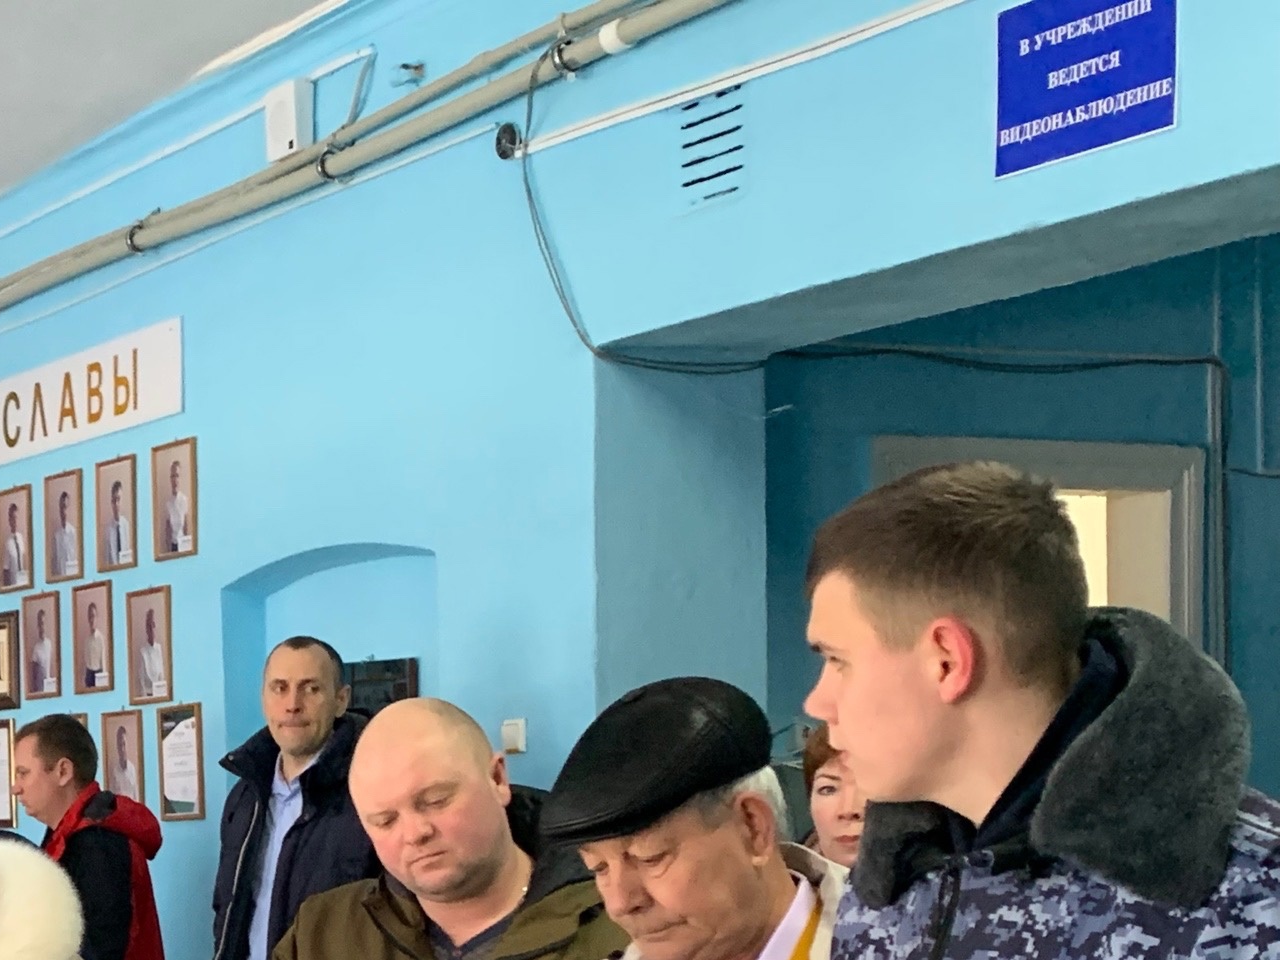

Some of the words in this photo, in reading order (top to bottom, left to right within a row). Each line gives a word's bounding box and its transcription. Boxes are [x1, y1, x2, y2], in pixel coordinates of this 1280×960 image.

[1019, 38, 1030, 57] В
[1034, 0, 1152, 51] УЧРЕЖДЕНИИ
[1047, 49, 1121, 90] ВЕДЕТСЯ
[999, 77, 1173, 147] ВИДЕОНАБЛЮДЕНИЕ
[2, 347, 139, 449] СЛАВЫ
